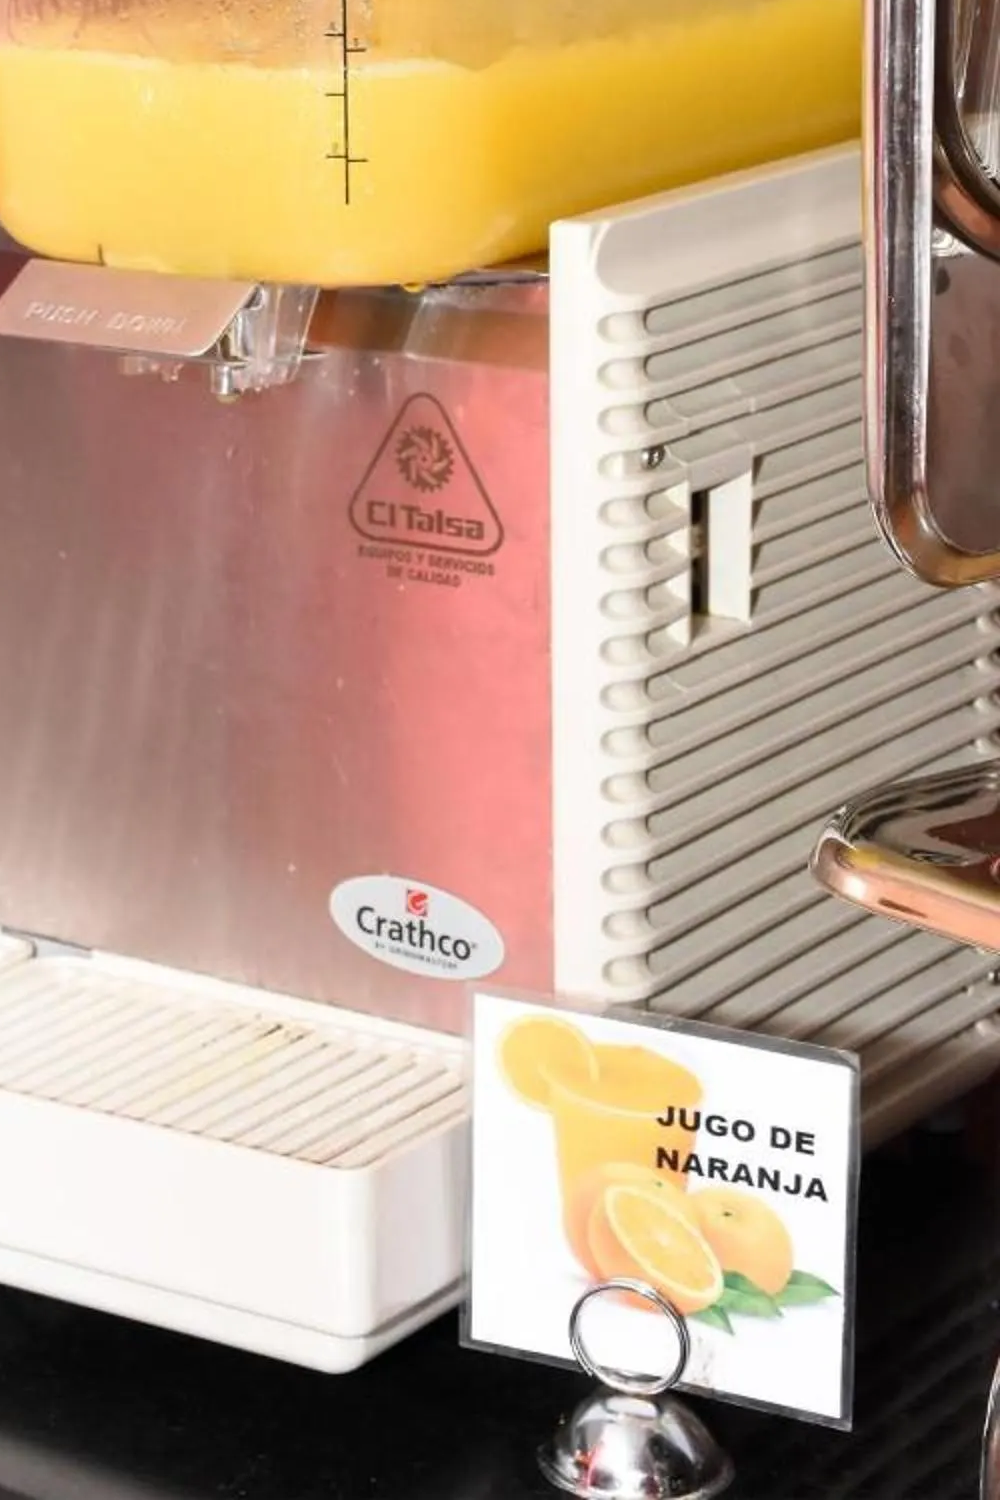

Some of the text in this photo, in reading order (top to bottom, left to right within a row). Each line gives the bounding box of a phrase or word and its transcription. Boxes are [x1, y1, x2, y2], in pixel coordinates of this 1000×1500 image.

[401, 504, 484, 541] Talsa
[355, 906, 472, 961] Crathco
[656, 1105, 815, 1156] JUGO DE
[656, 1146, 829, 1203] NARANJA
